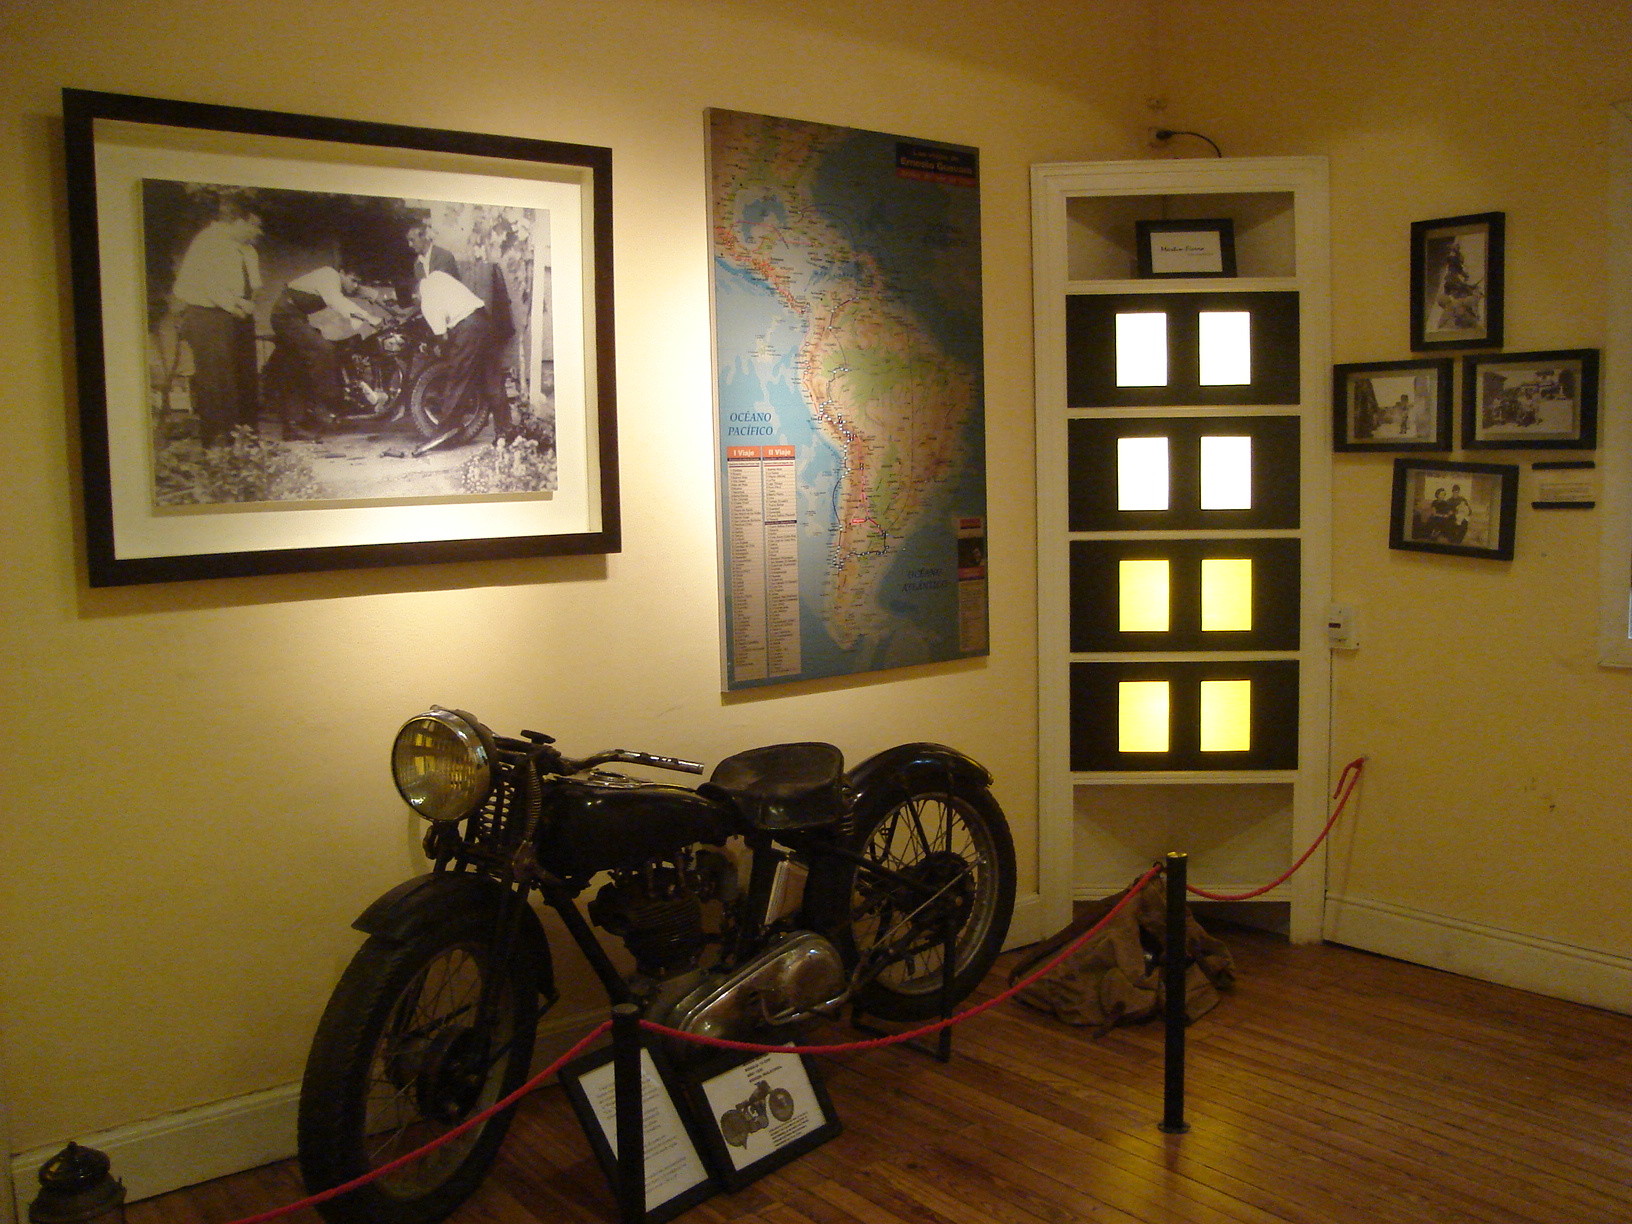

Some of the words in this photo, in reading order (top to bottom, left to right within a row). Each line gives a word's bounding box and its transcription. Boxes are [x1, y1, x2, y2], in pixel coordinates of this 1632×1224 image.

[729, 411, 772, 422] OCÉANO
[728, 425, 774, 436] PACÍFICO
[737, 449, 754, 457] Viaje
[774, 449, 791, 457] Viaje
